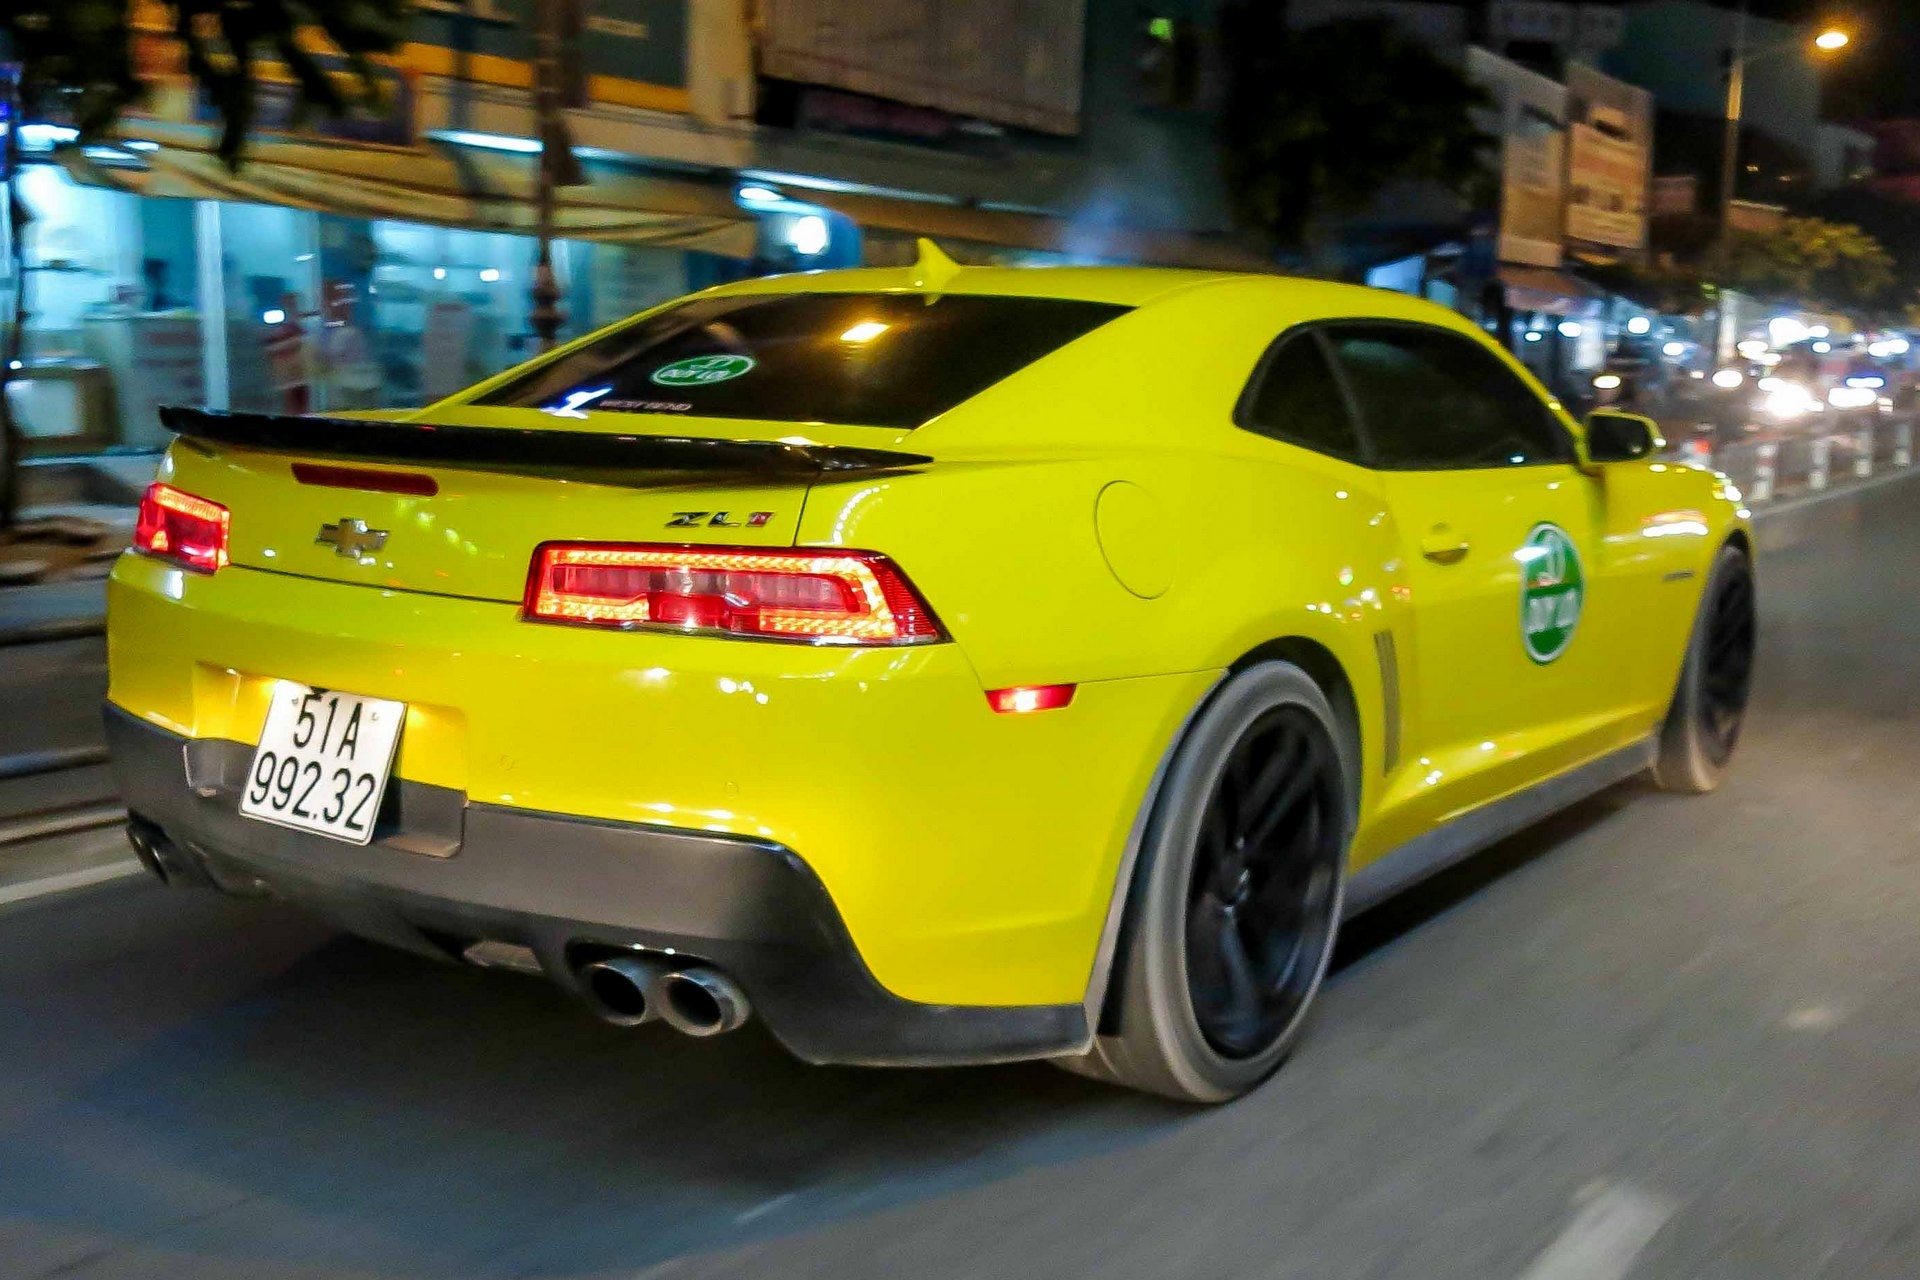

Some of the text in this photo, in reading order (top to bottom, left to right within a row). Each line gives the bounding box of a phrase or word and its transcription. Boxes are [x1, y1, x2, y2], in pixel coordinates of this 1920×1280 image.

[665, 511, 774, 528] ZL1
[293, 693, 363, 761] 51A
[250, 751, 376, 832] 992.32
